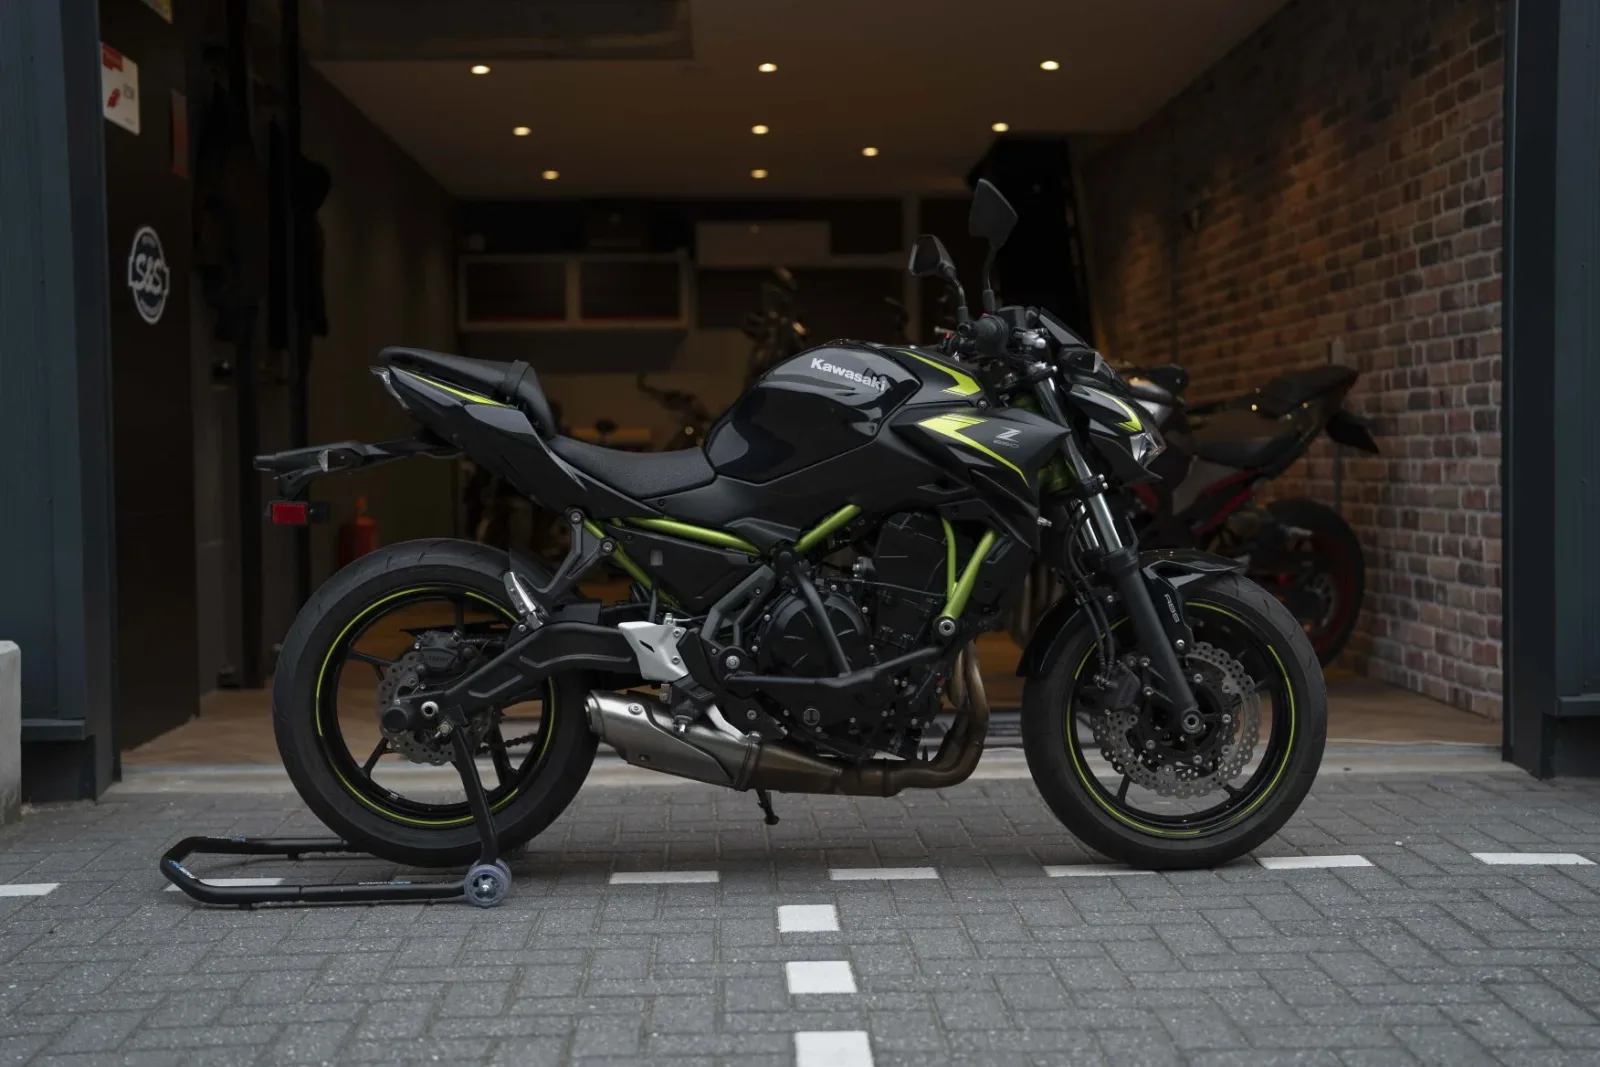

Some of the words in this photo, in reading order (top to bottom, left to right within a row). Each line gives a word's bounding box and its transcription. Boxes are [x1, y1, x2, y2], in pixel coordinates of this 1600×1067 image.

[810, 357, 886, 392] Kawasaki
[995, 426, 1022, 443] Z
[1163, 593, 1180, 623] ABS
